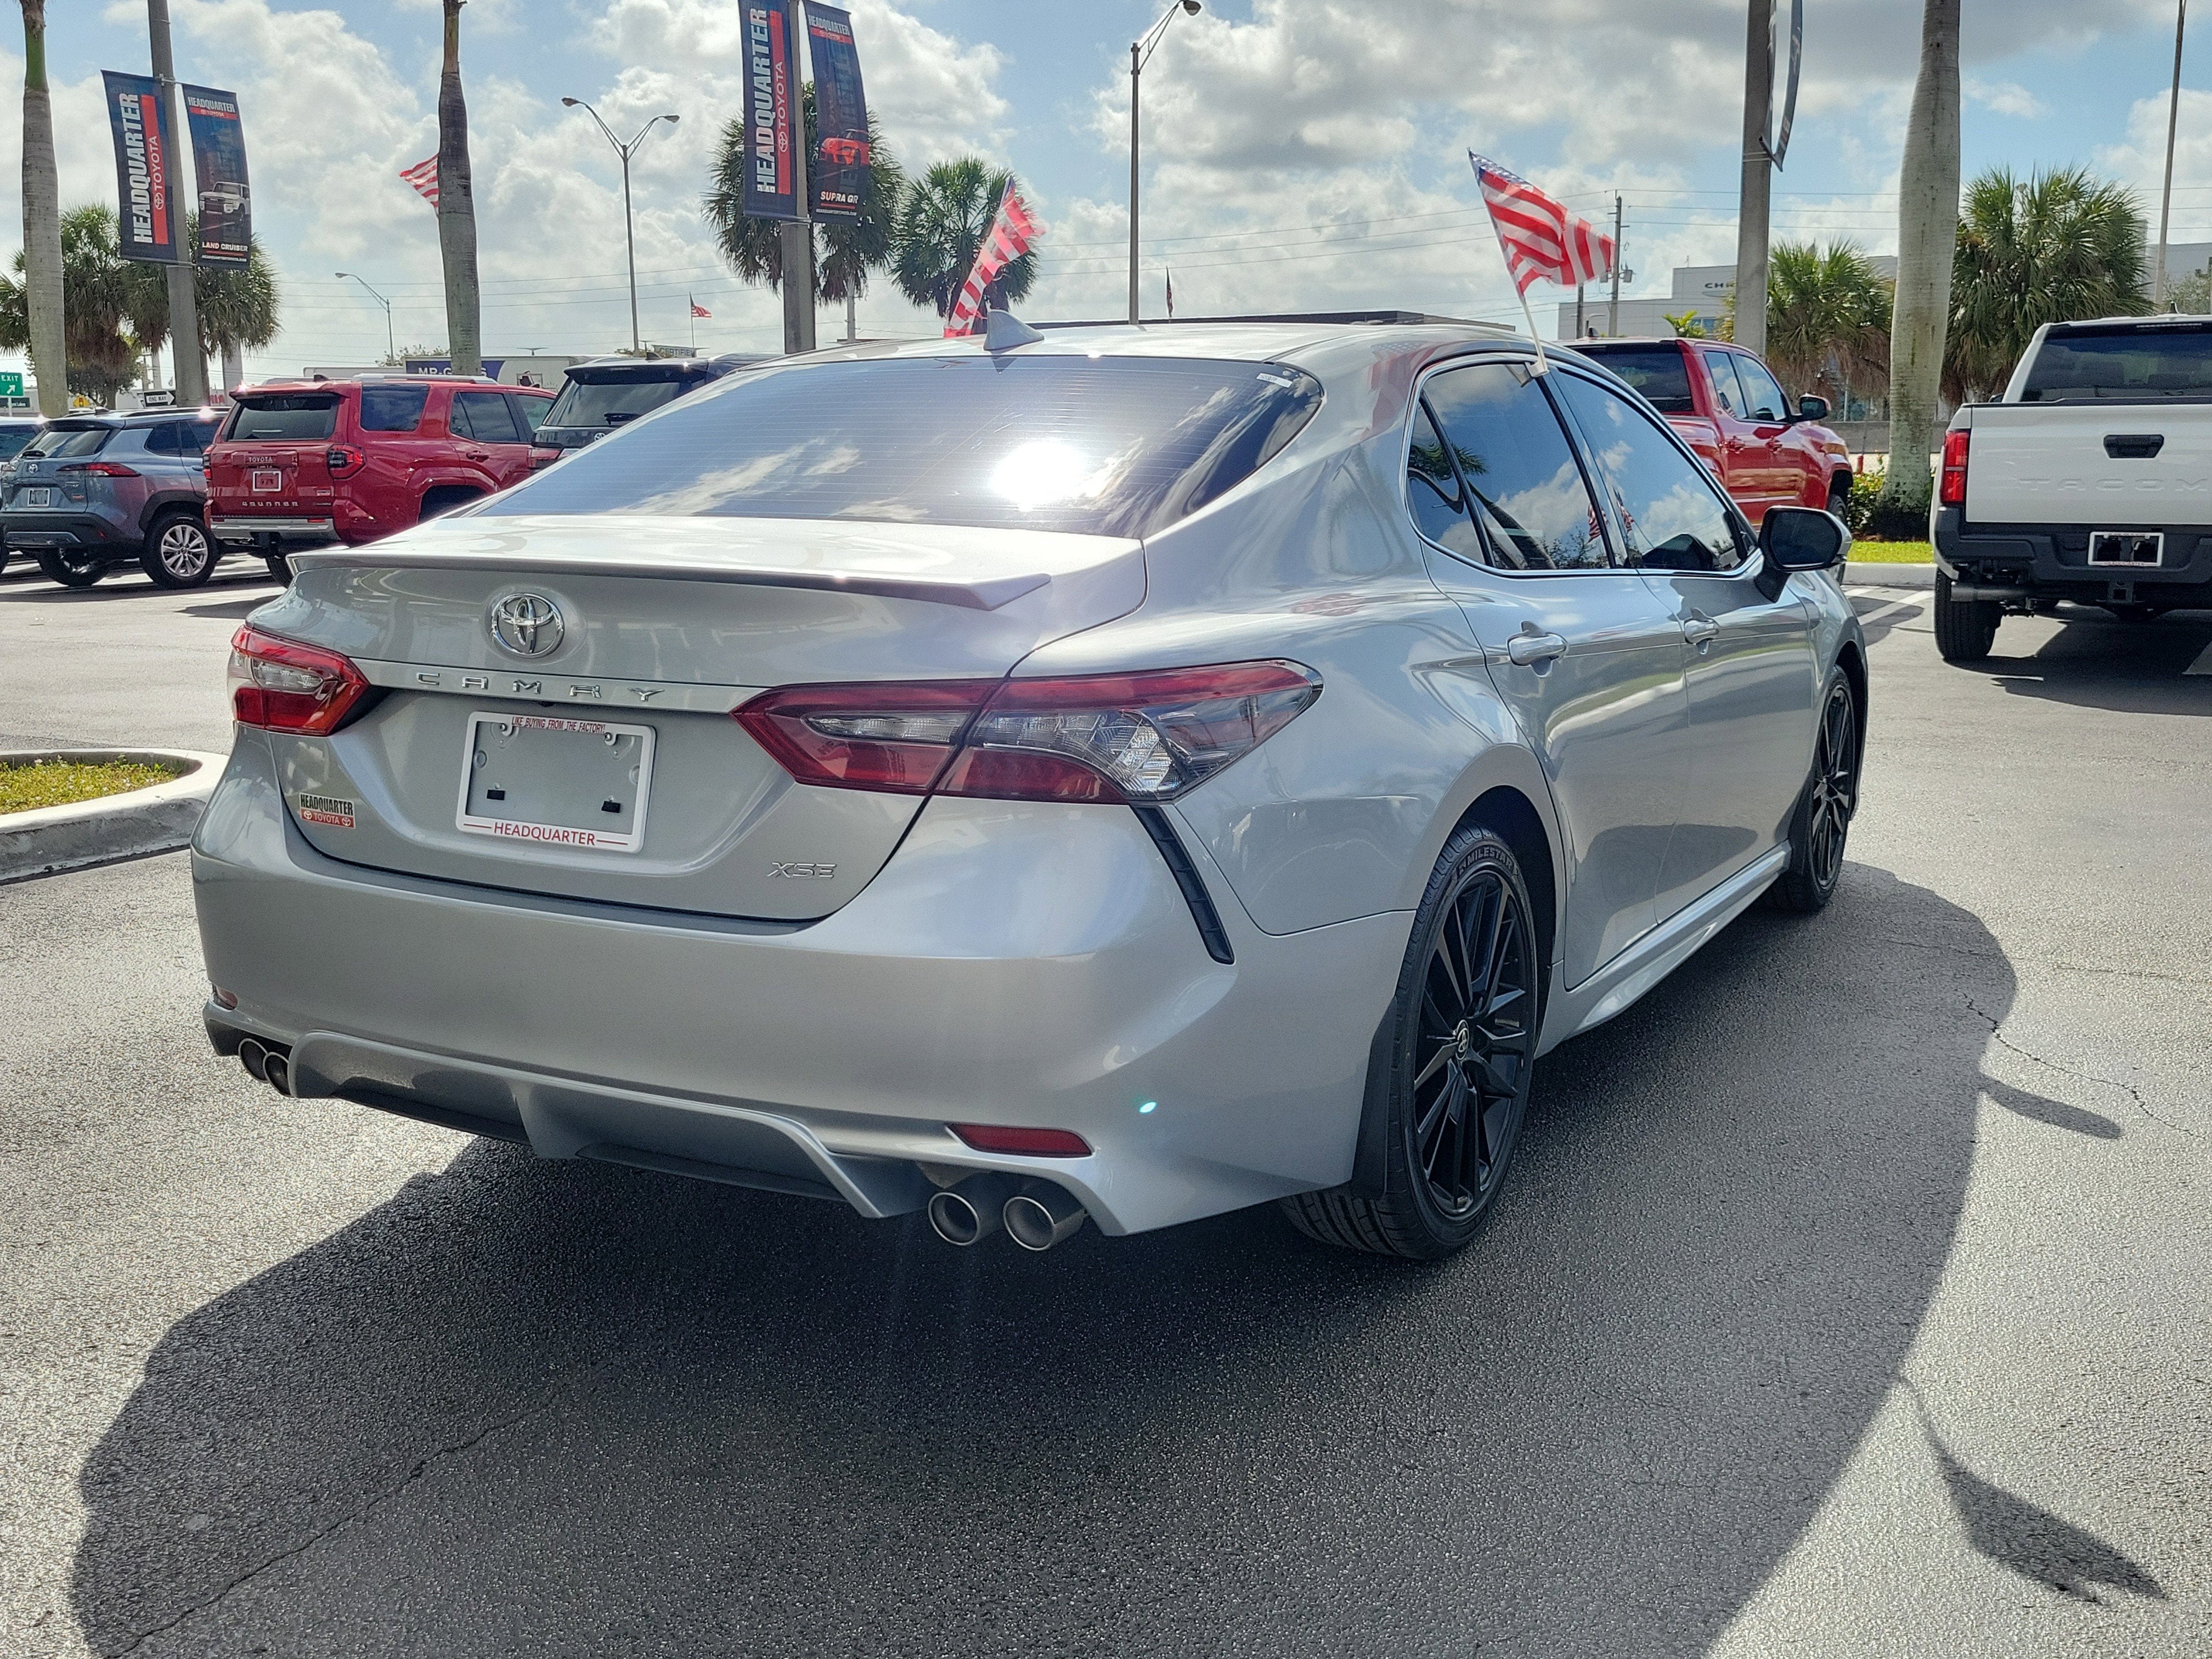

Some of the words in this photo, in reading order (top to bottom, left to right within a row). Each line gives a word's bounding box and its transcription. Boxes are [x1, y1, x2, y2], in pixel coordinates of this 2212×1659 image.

[187, 96, 236, 113] HEADQUARTER
[750, 8, 776, 194] HEADQUARTER
[775, 61, 786, 129] TOYOTA
[119, 93, 153, 244] HEADQUARTER
[149, 136, 163, 190] TOYOTA
[820, 191, 845, 202] SUPRA
[847, 194, 859, 204] GR
[221, 243, 249, 252] CRUISER
[415, 672, 665, 702] CAMRY
[511, 716, 523, 725] LIKE
[524, 717, 546, 728] BUYING
[546, 719, 565, 730] FROM
[565, 721, 577, 731] THE
[300, 793, 353, 816] HEADQUARTER
[313, 812, 340, 825] TOYOTA
[494, 821, 595, 846] HEADQUARTER
[767, 861, 837, 879] XSE
[1467, 847, 1514, 870] MILESTAR
